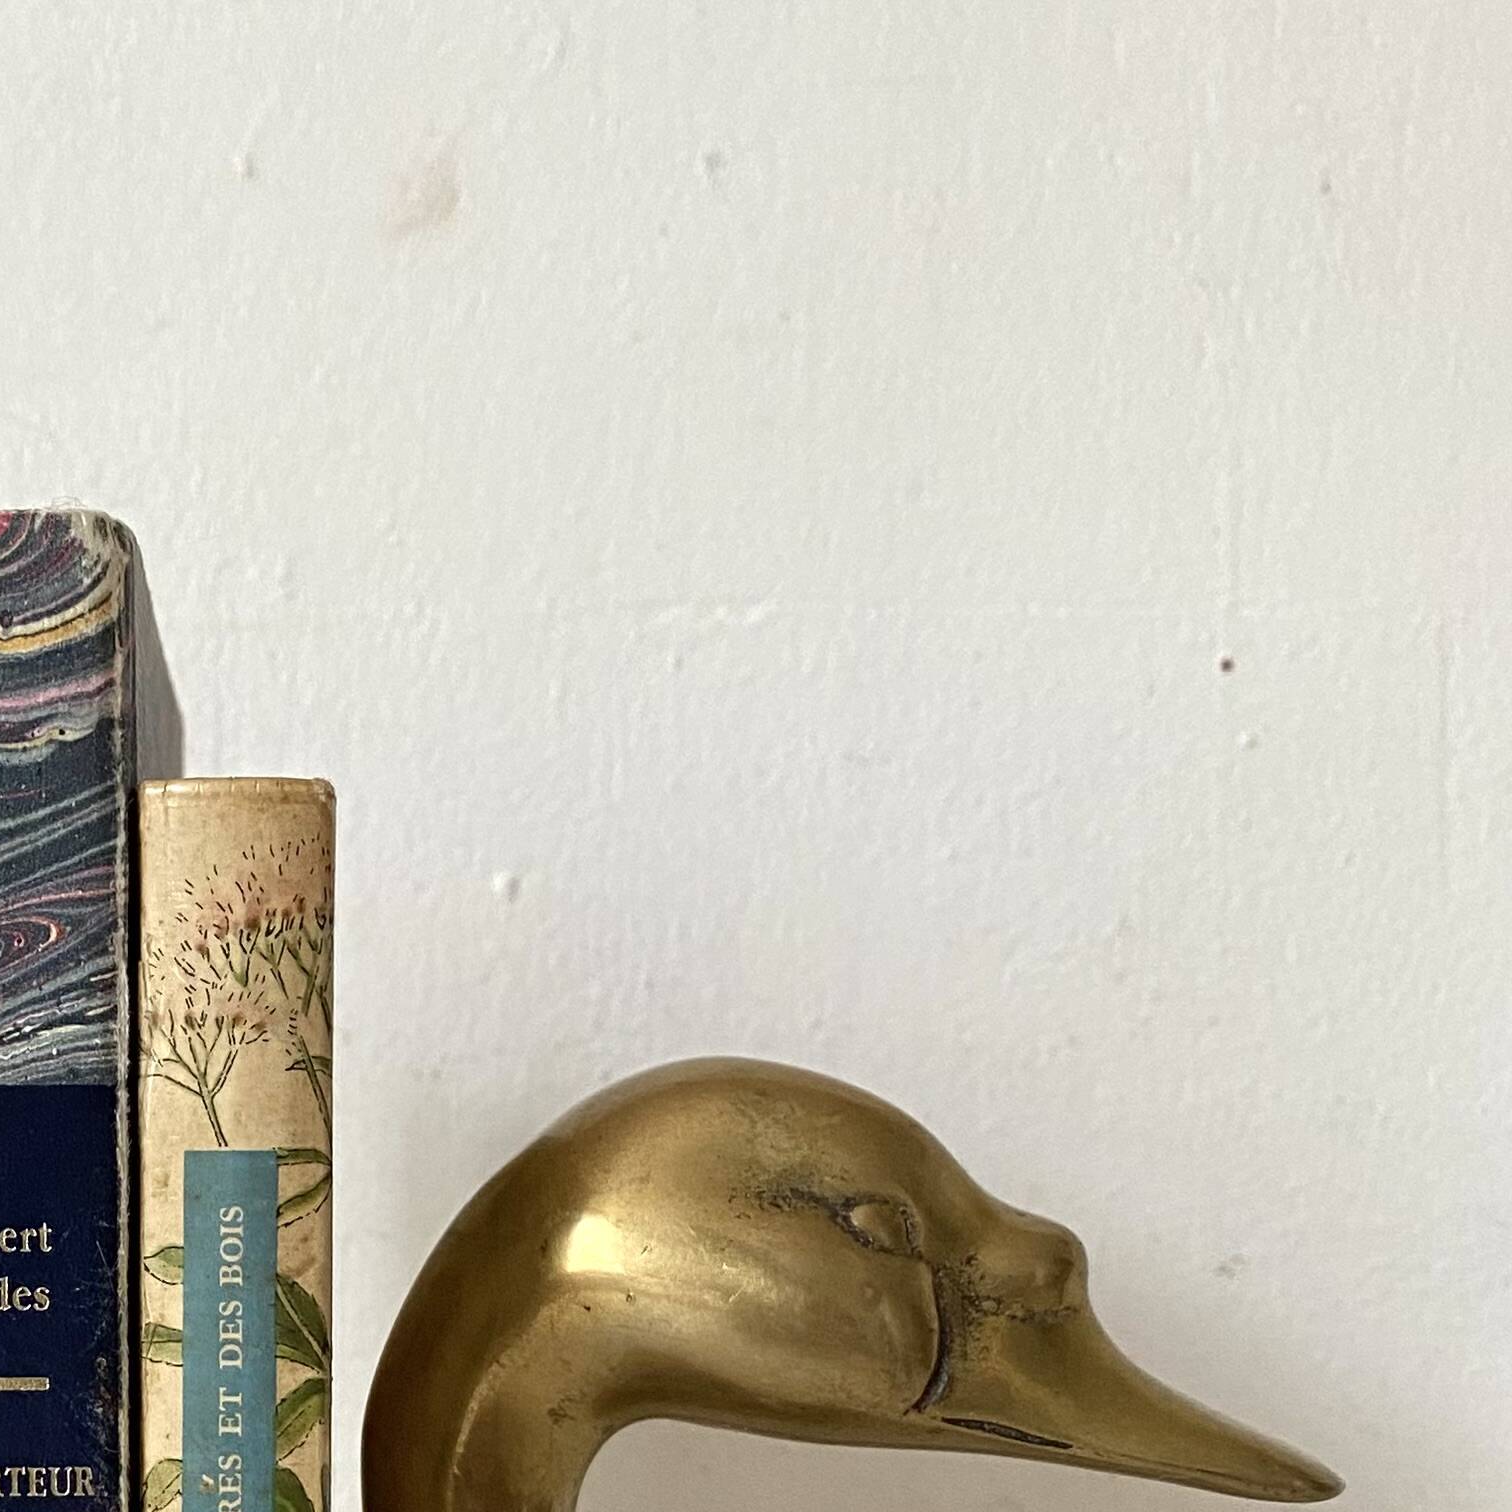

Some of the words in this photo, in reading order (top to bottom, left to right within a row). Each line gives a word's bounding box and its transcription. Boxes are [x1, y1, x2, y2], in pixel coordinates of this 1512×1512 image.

[219, 1205, 245, 1287] BOIS
[218, 1300, 243, 1370] DES
[217, 1388, 243, 1437] ET
